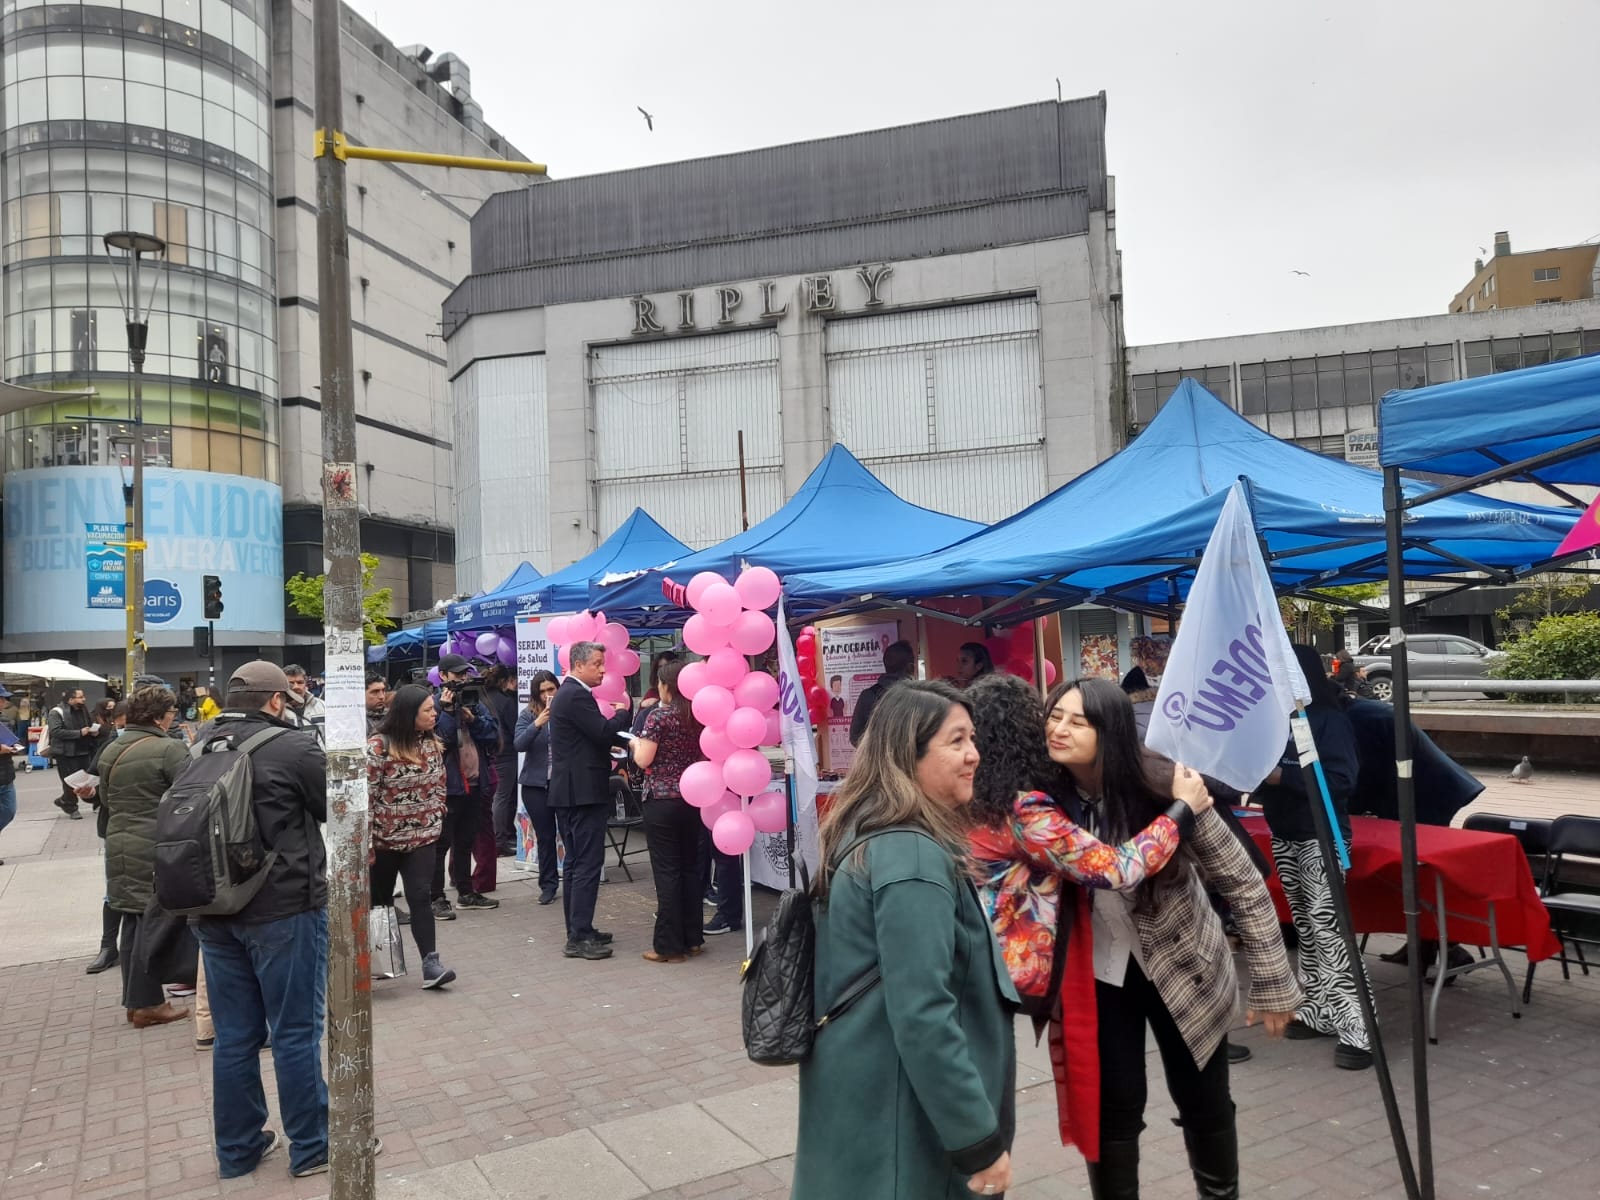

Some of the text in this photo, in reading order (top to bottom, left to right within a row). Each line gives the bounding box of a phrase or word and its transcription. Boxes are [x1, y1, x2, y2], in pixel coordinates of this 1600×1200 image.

[631, 263, 893, 334] RIPLEY
[93, 524, 109, 533] PLAN
[22, 538, 83, 572] BUEN
[145, 538, 213, 571] LVER
[518, 640, 546, 650] SEREMI
[822, 638, 881, 656] MAMOGRAFÍA
[518, 653, 548, 663] de Salud
[518, 666, 545, 679] Regió
[518, 680, 529, 689] del
